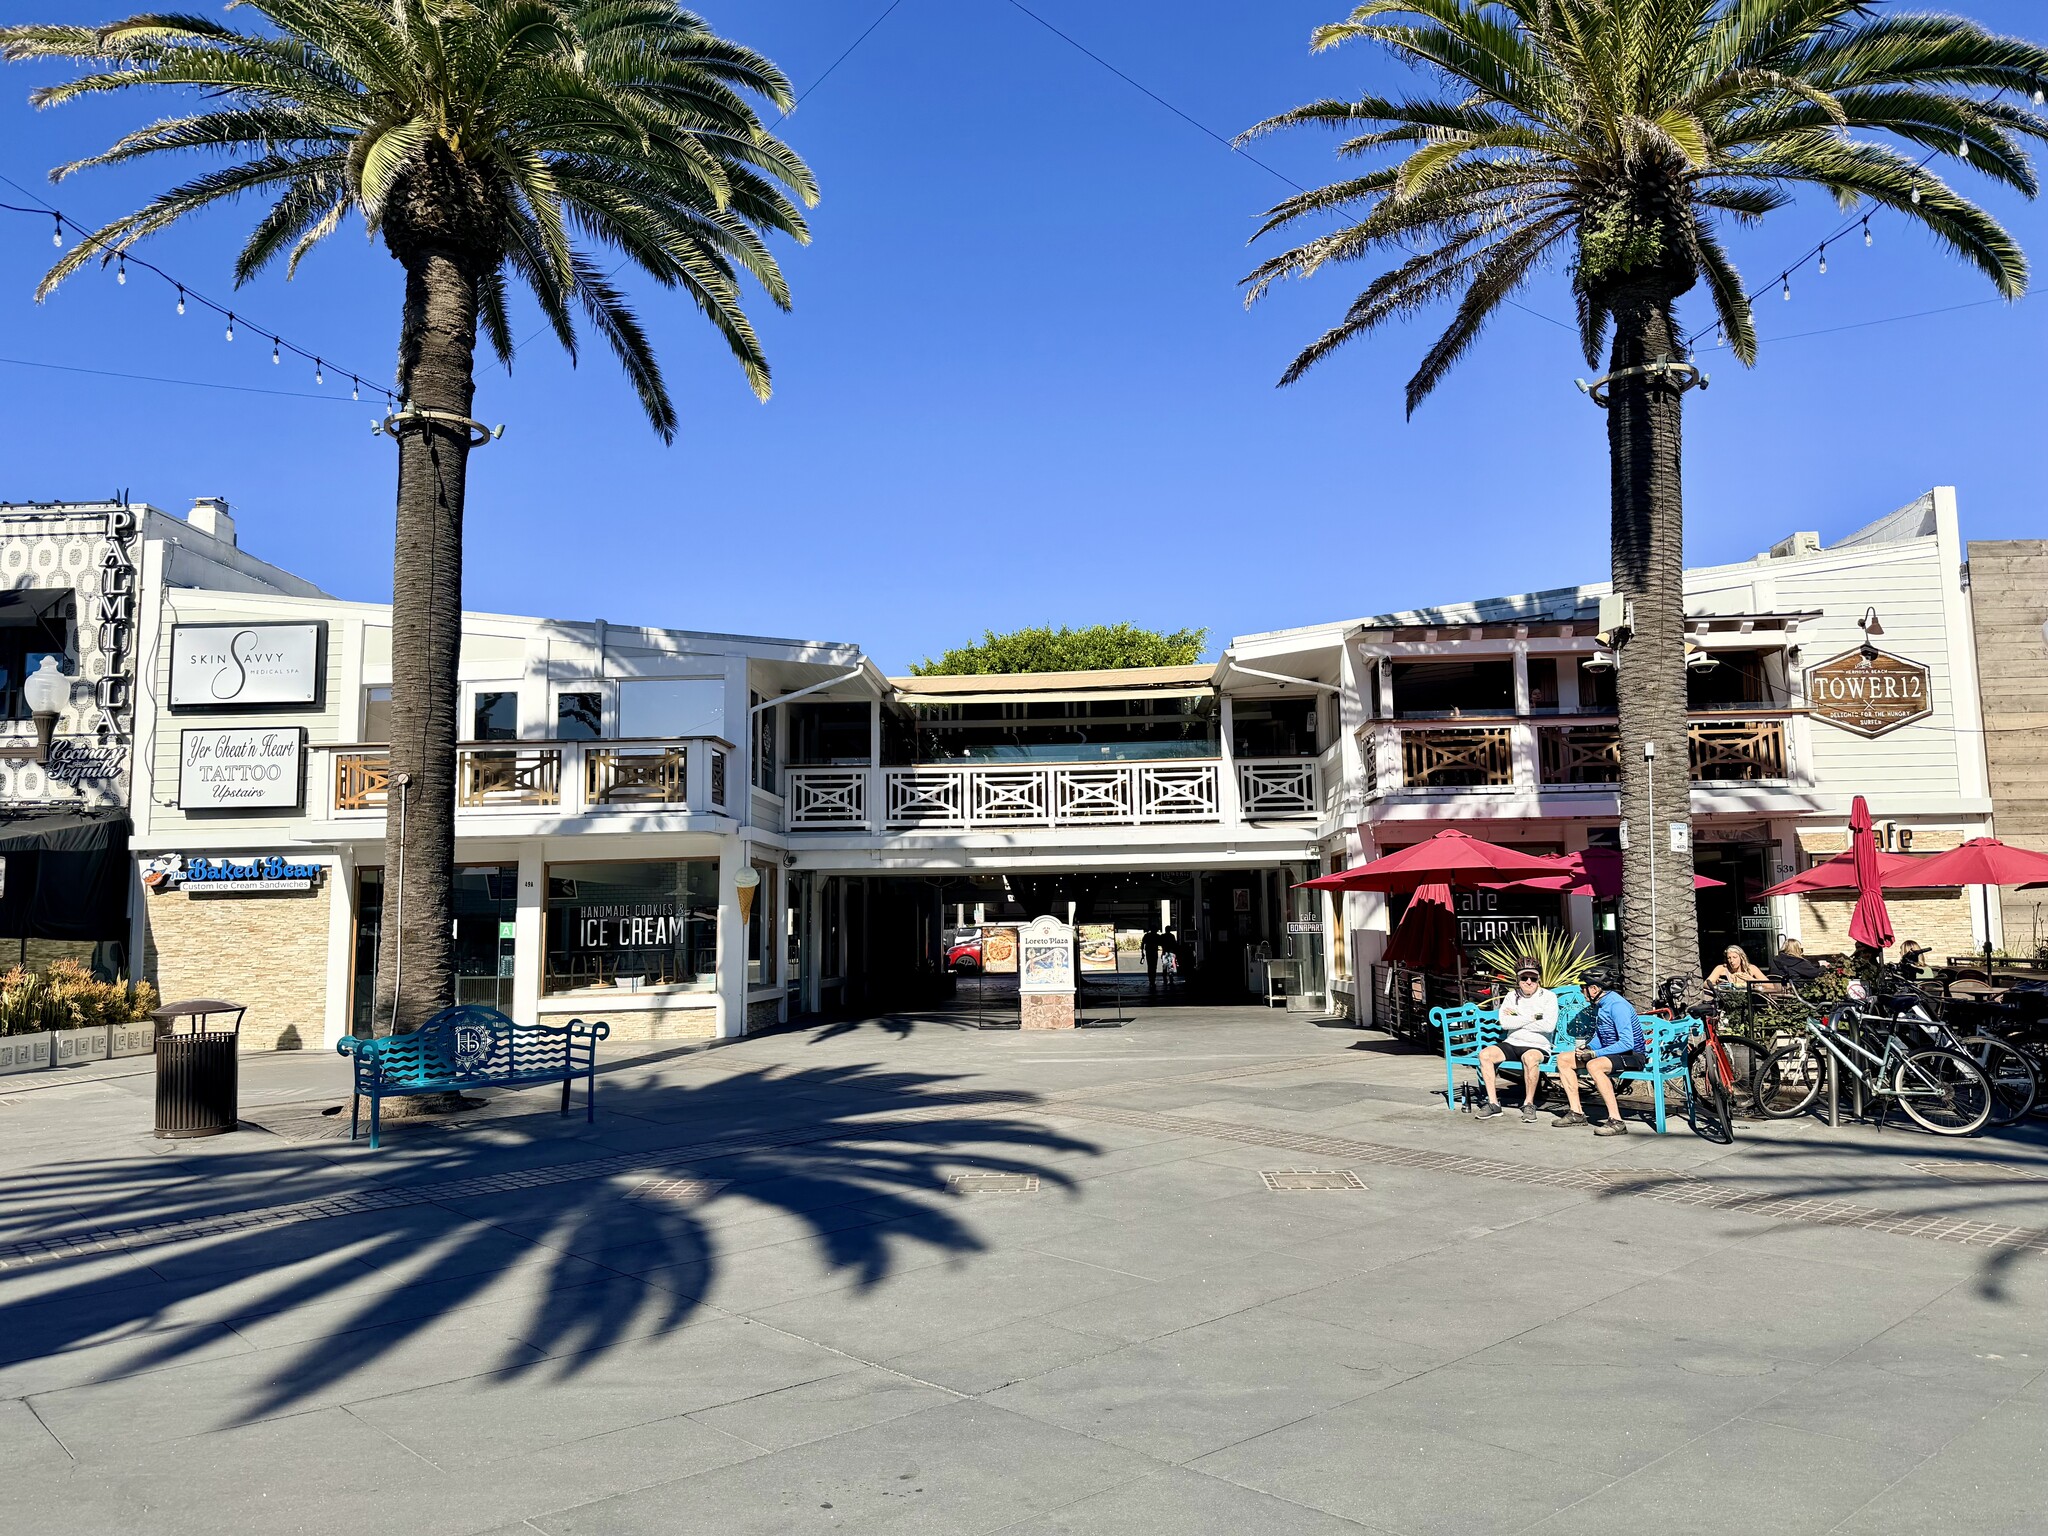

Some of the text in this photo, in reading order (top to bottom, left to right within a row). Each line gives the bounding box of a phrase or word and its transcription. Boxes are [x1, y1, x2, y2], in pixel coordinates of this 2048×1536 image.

[92, 511, 131, 736] PALMILLA
[190, 655, 226, 665] SKIN
[1814, 675, 1922, 700] TOWER12
[186, 733, 295, 767] Yer Cheat'n Heart
[47, 759, 122, 787] Tequila
[199, 764, 281, 782] TATTOO
[212, 784, 266, 802] Upstairs
[1872, 822, 1913, 848] afe
[169, 855, 321, 881] The Baked Bear
[182, 882, 215, 890] Custom
[230, 881, 257, 889] Cream
[259, 880, 308, 889] Sandwiches
[580, 903, 685, 918] HANDMADE COOKIES &
[1300, 912, 1317, 921] cafe
[502, 926, 510, 935] A
[580, 916, 684, 947] ICE CREAM
[1290, 923, 1323, 932] BONAPART
[1025, 937, 1048, 945] Loreto
